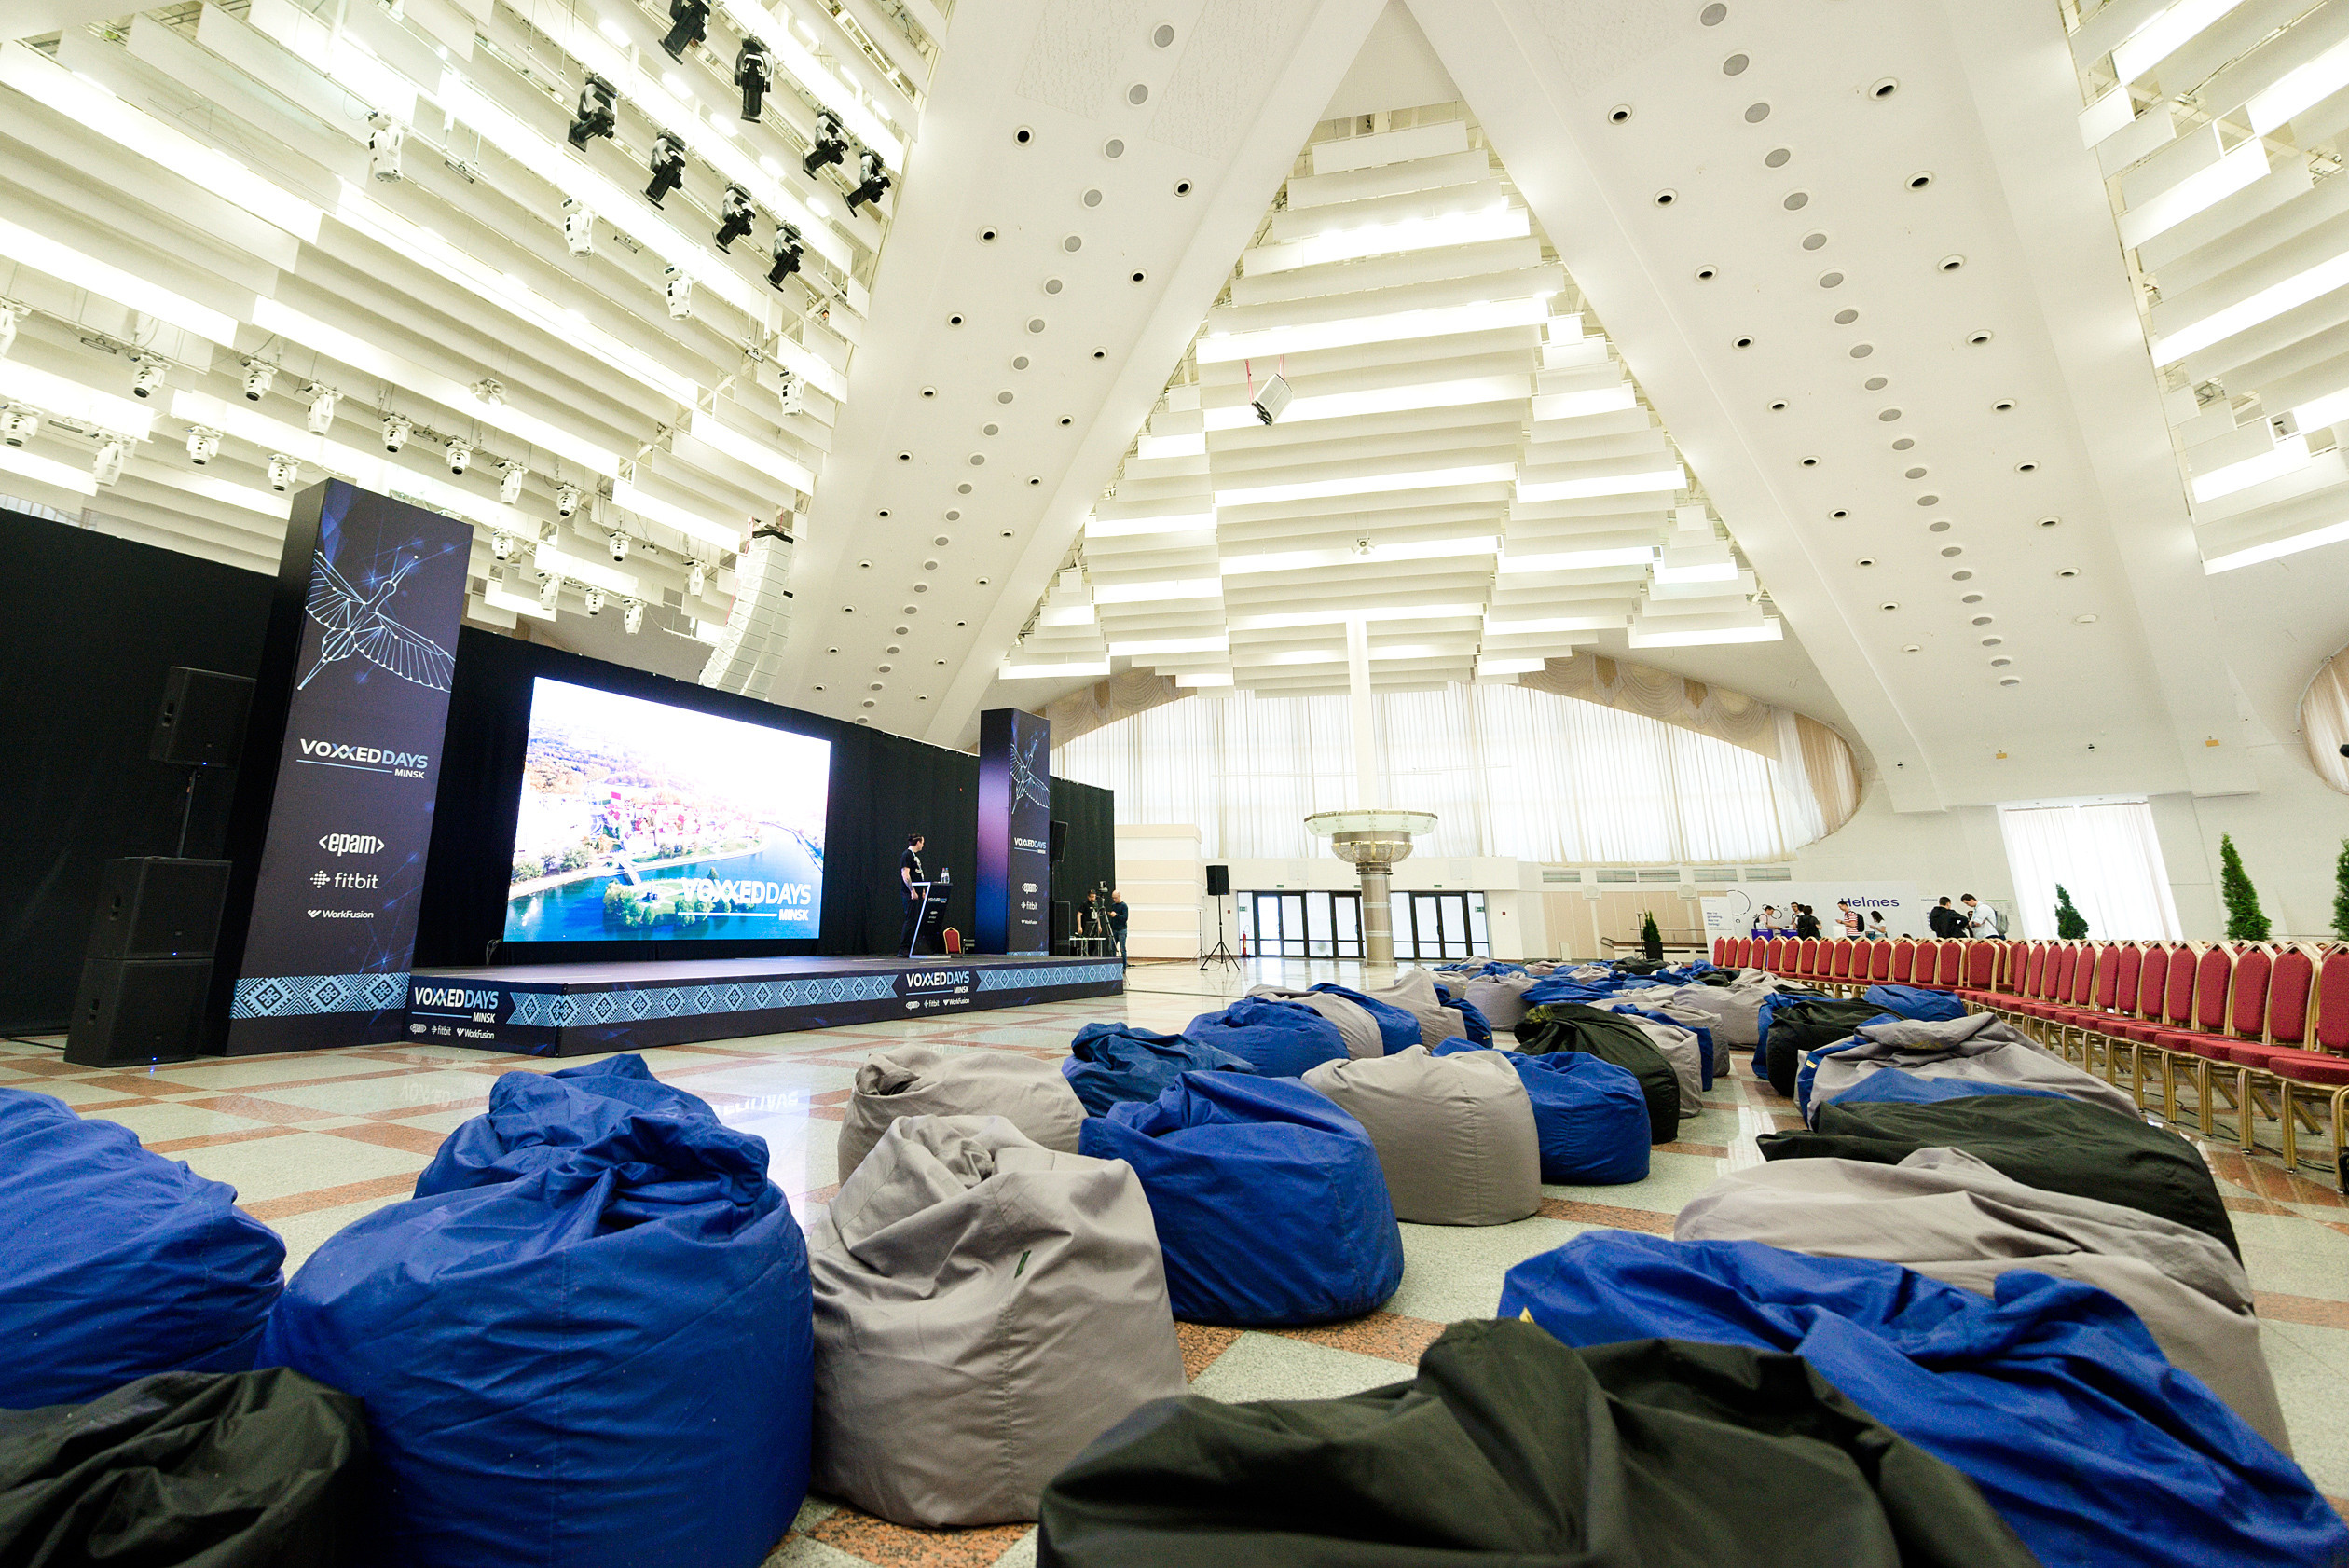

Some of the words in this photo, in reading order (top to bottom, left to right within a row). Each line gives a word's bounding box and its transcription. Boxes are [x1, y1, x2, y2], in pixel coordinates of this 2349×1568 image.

[394, 768, 425, 779] MINSK
[334, 872, 378, 889] fitbit
[1841, 896, 1900, 908] Helmes
[322, 909, 375, 919] WorkFusion
[778, 908, 809, 921] MINSK
[473, 1012, 496, 1024] MINSK
[437, 1025, 451, 1036] fitbit
[464, 1028, 495, 1039] WorkFusion
